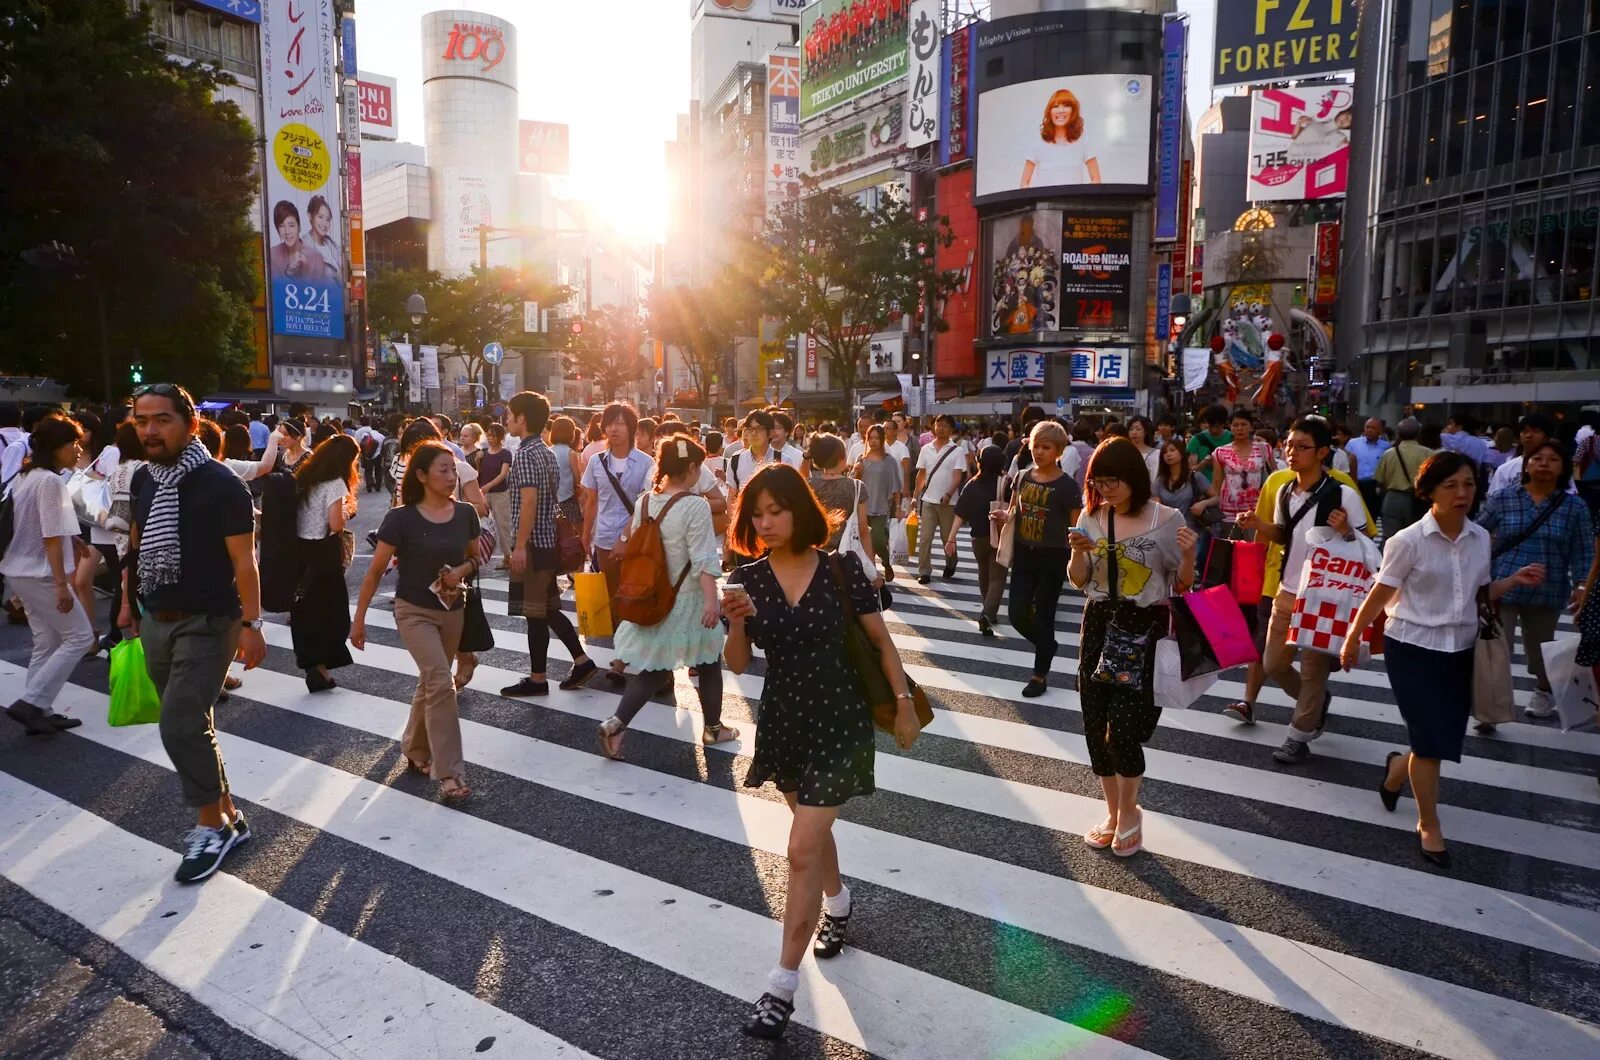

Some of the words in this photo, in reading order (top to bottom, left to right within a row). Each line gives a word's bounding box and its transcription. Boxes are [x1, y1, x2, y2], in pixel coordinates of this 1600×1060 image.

[978, 33, 1005, 48] Mighty
[1006, 27, 1032, 41] Vision
[442, 31, 506, 72] 109
[1219, 33, 1341, 75] FOREVER
[811, 80, 845, 107] TEIKYO
[845, 50, 906, 90] UNIVERSITY
[910, 11, 938, 138] もんじゃ
[281, 131, 322, 149] フジテレビ
[776, 149, 795, 160] まで
[1254, 151, 1288, 168] 7.25
[1063, 252, 1089, 264] ROAD
[1101, 254, 1130, 265] NINJA
[285, 283, 331, 313] 8.24
